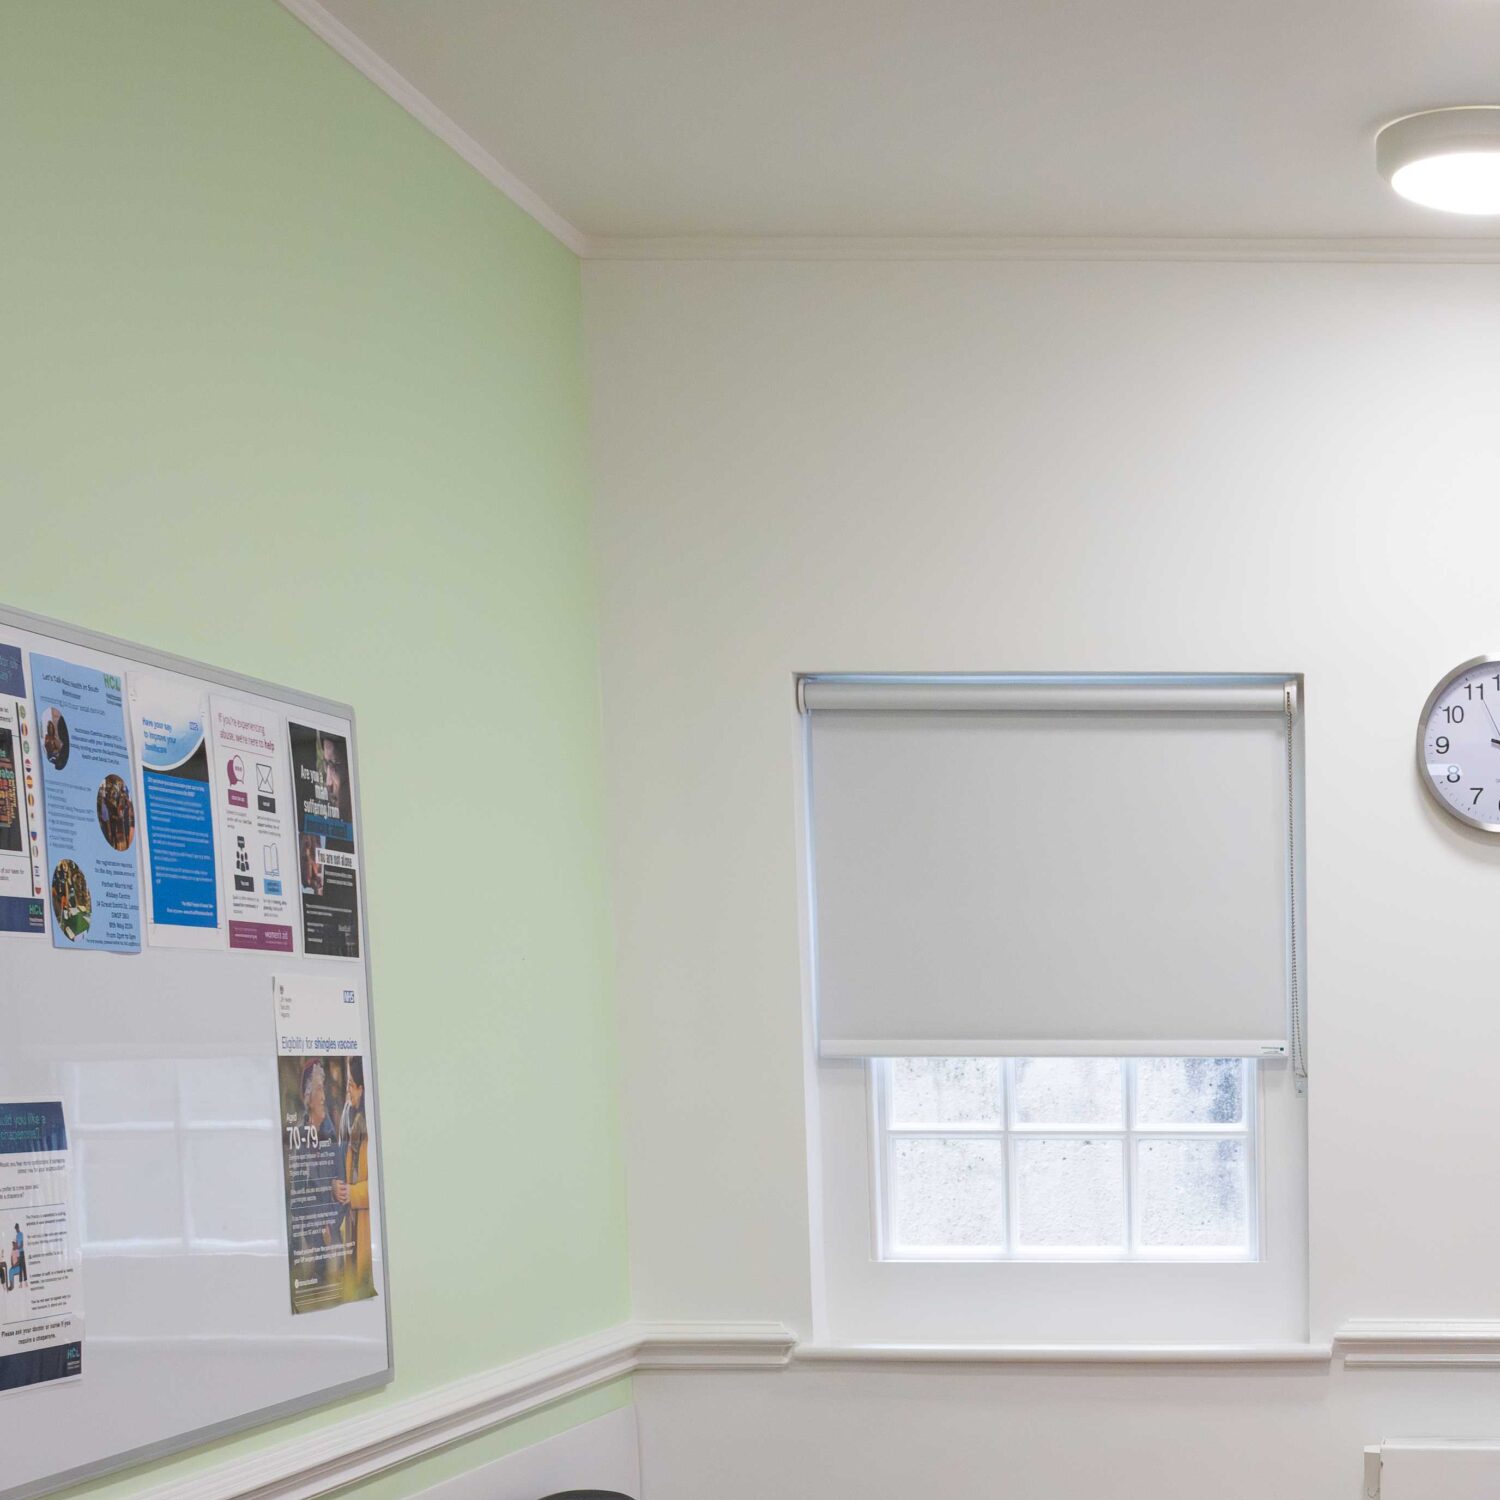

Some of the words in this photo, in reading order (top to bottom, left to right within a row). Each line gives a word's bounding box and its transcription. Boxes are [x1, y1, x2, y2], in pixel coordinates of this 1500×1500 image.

[1464, 683, 1484, 700] 11
[1442, 706, 1464, 724] 10
[264, 740, 275, 752] help
[1436, 736, 1449, 754] 9
[301, 765, 310, 780] Are
[310, 770, 320, 783] you
[1446, 765, 1460, 783] 8
[1470, 787, 1483, 804] 7
[304, 798, 327, 817] suffering
[327, 803, 340, 818] from
[318, 850, 326, 861] You
[341, 854, 352, 867] alone
[343, 990, 355, 1003] NHS
[282, 1036, 304, 1052] Eligibility
[314, 1036, 336, 1052] shingles
[337, 1037, 358, 1049] vaccine
[286, 1112, 297, 1123] Aged
[286, 1125, 318, 1149] 70-79
[1, 1330, 15, 1338] Please
[23, 1328, 31, 1336] your
[36, 1333, 56, 1342] chaperone.
